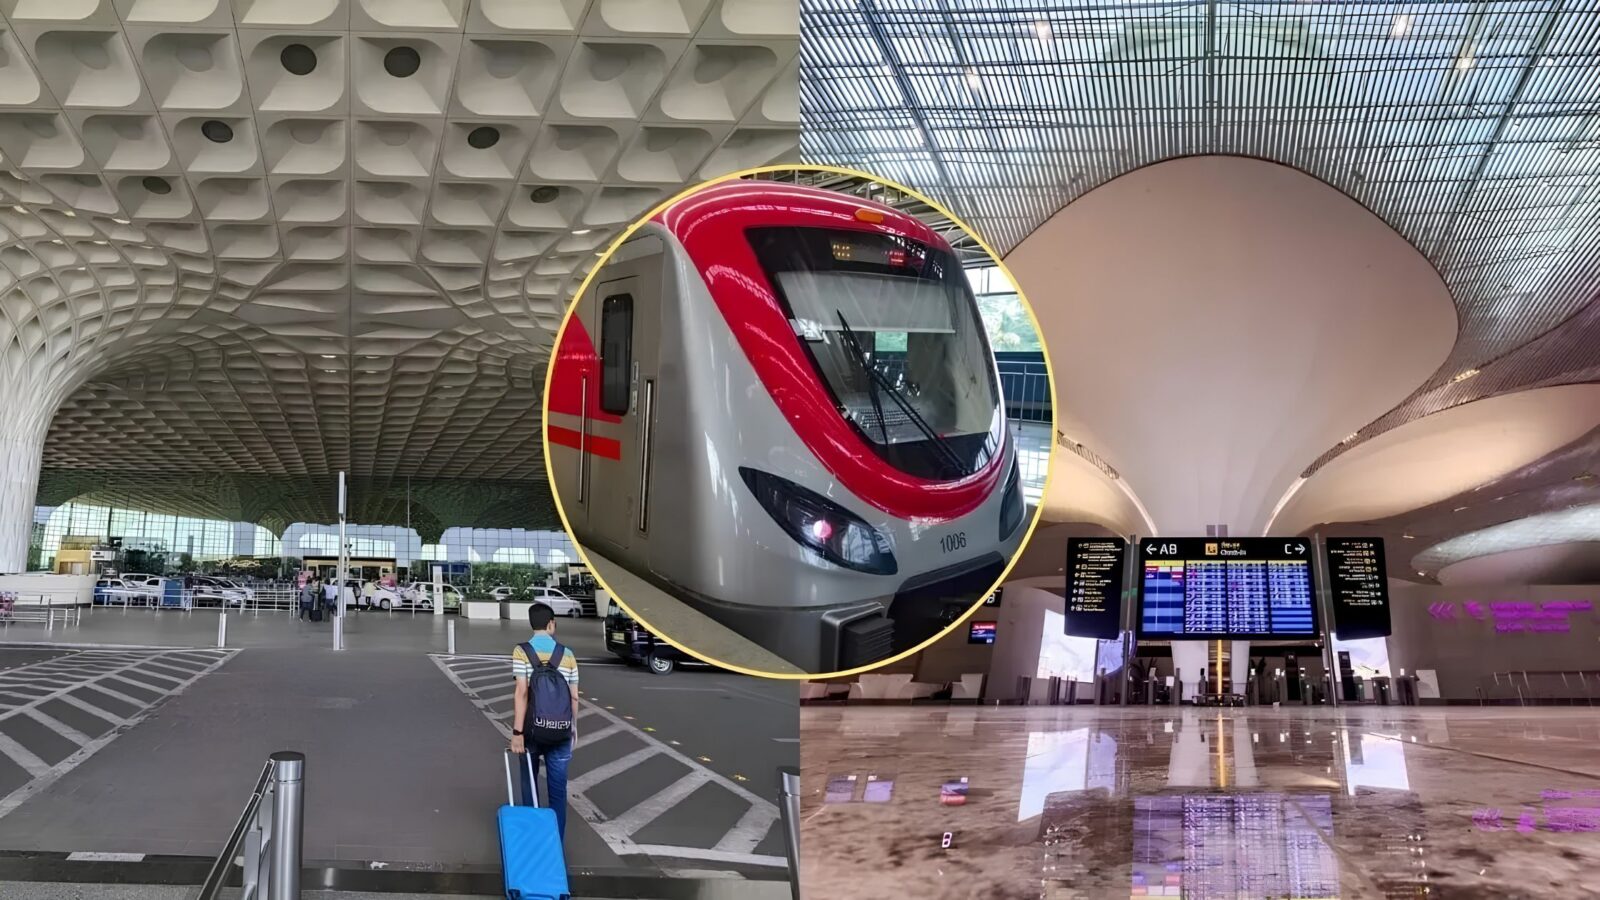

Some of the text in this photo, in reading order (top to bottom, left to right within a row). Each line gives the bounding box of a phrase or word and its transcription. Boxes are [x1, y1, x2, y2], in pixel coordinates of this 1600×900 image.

[940, 531, 967, 554] 1006
[1159, 543, 1178, 555] AB
[1284, 543, 1292, 555] C
